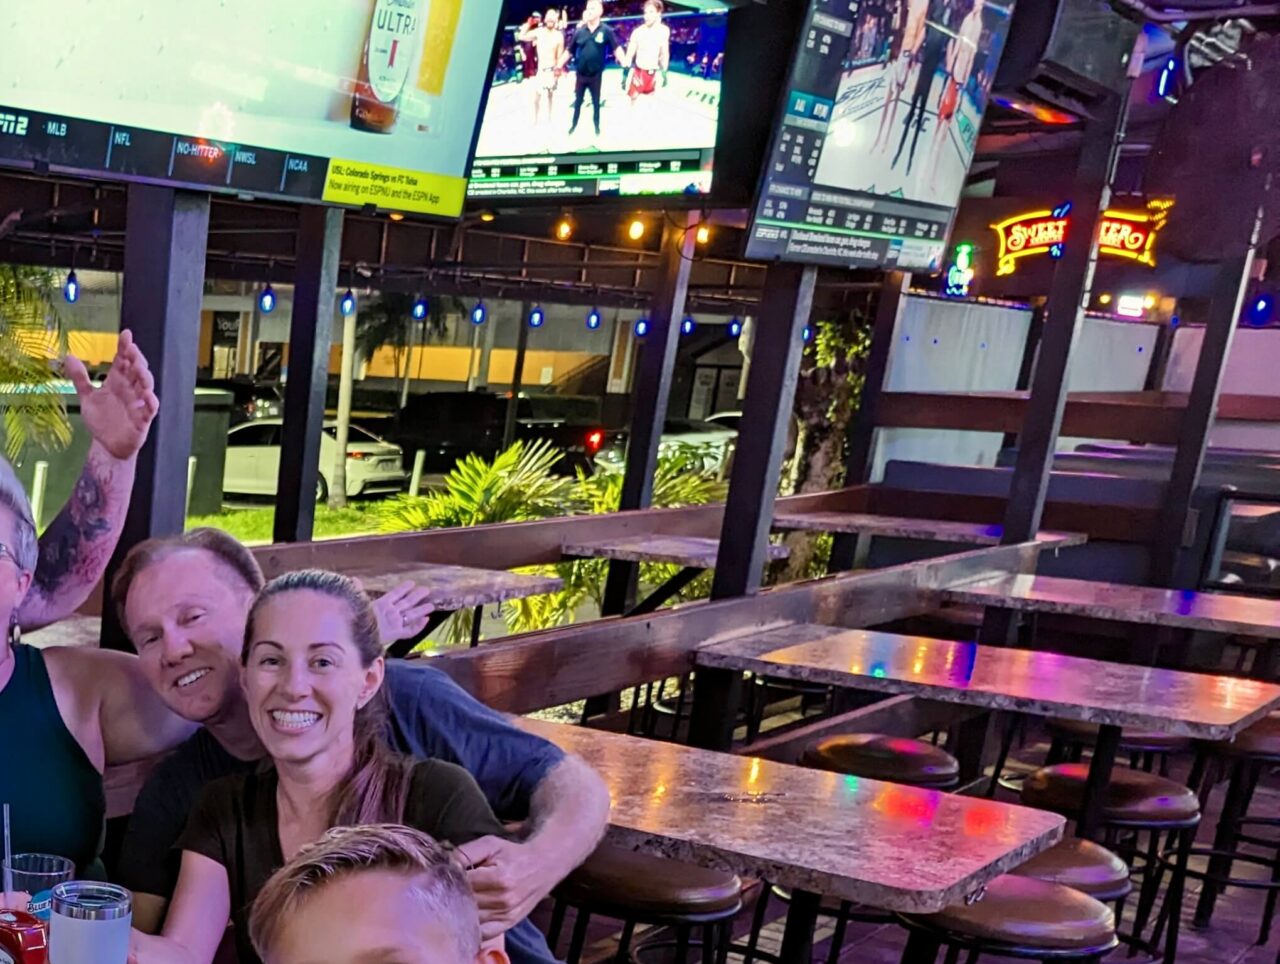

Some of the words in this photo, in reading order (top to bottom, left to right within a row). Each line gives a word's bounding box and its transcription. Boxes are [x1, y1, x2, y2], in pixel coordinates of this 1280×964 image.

[47, 121, 67, 137] MLB
[114, 131, 131, 147] NFL
[176, 141, 219, 160] NO-HITTER
[234, 150, 256, 165] NWSL
[288, 158, 308, 172] NCAA
[332, 164, 345, 176] USL:
[345, 167, 370, 180] Colorado
[370, 171, 390, 184] Springs
[329, 180, 342, 191] Now
[343, 182, 361, 196] airing
[391, 187, 401, 198] and
[402, 189, 412, 200] the
[412, 190, 428, 201] ESPN
[428, 193, 440, 204] App
